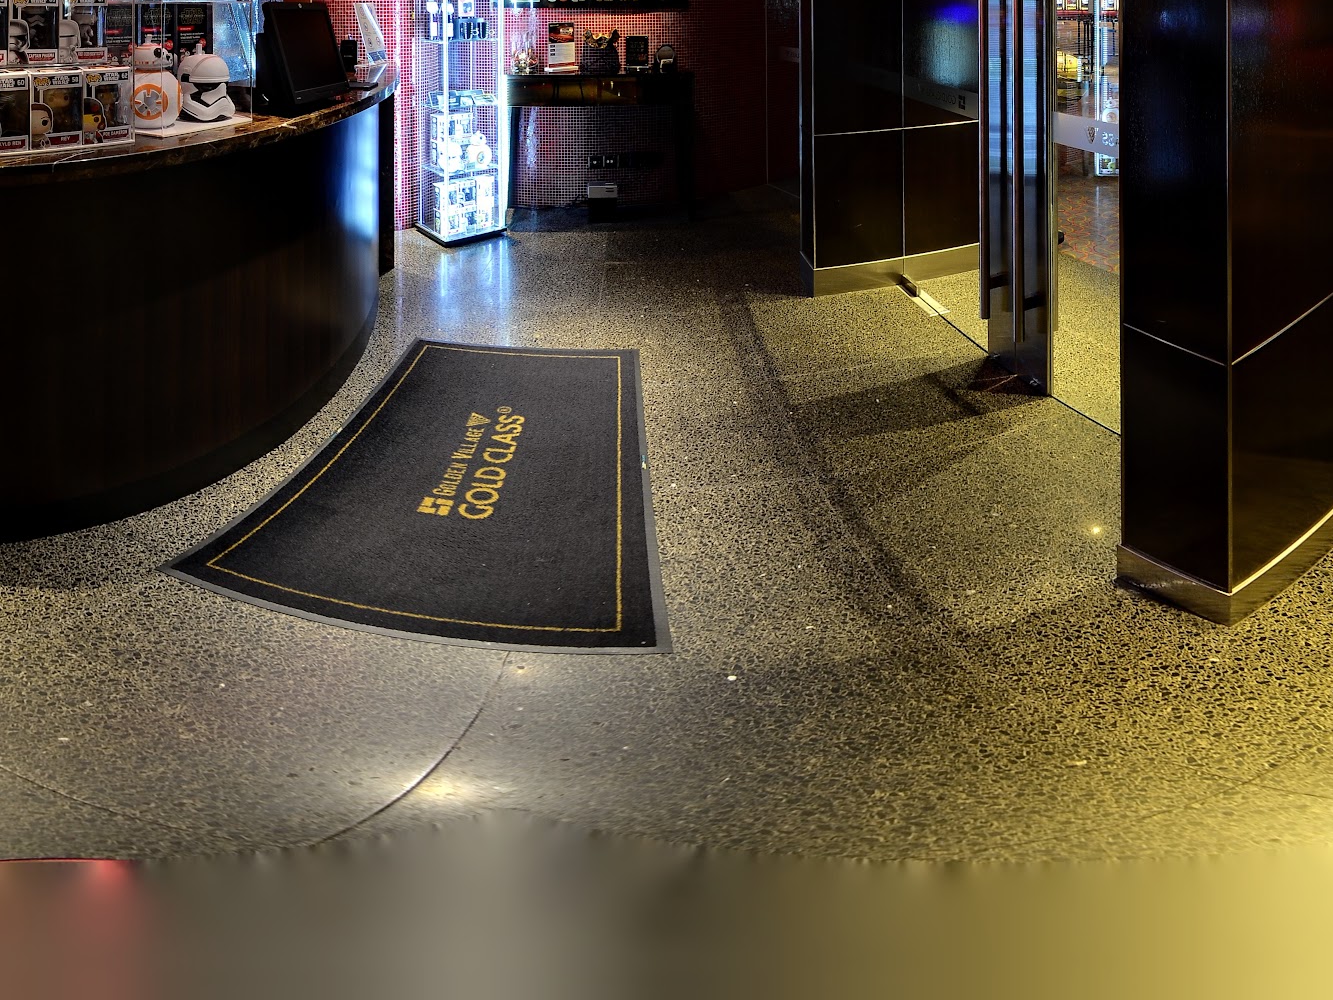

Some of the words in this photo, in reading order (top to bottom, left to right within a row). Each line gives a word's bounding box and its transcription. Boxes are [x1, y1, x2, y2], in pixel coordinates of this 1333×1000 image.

[432, 461, 468, 496] GOLDEN
[451, 428, 485, 459] VILLAGE
[458, 466, 507, 519] GOLD
